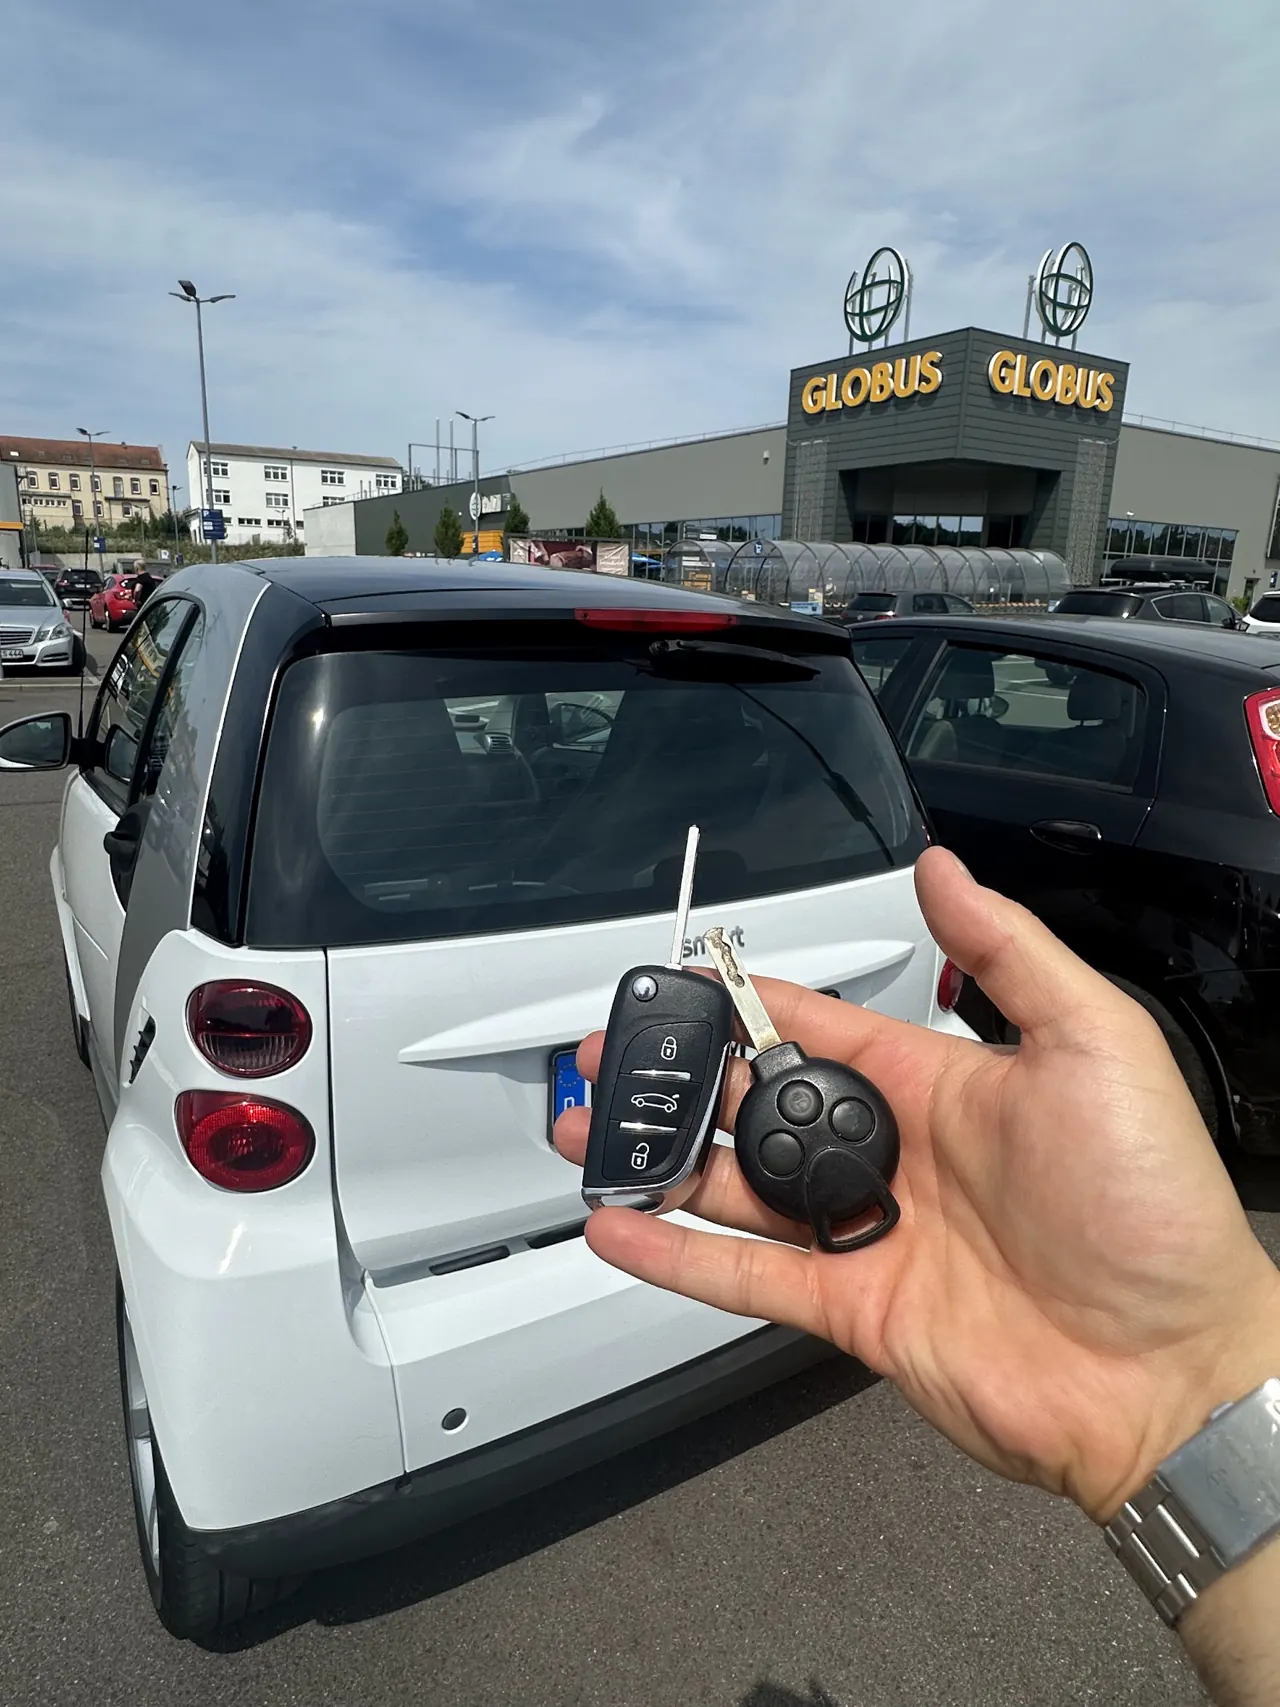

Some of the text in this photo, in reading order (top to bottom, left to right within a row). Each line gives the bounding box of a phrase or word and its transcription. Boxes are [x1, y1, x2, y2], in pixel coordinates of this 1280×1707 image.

[801, 351, 943, 414] GLOBUS
[988, 350, 1115, 412] GLOBUS
[682, 925, 745, 958] smrt
